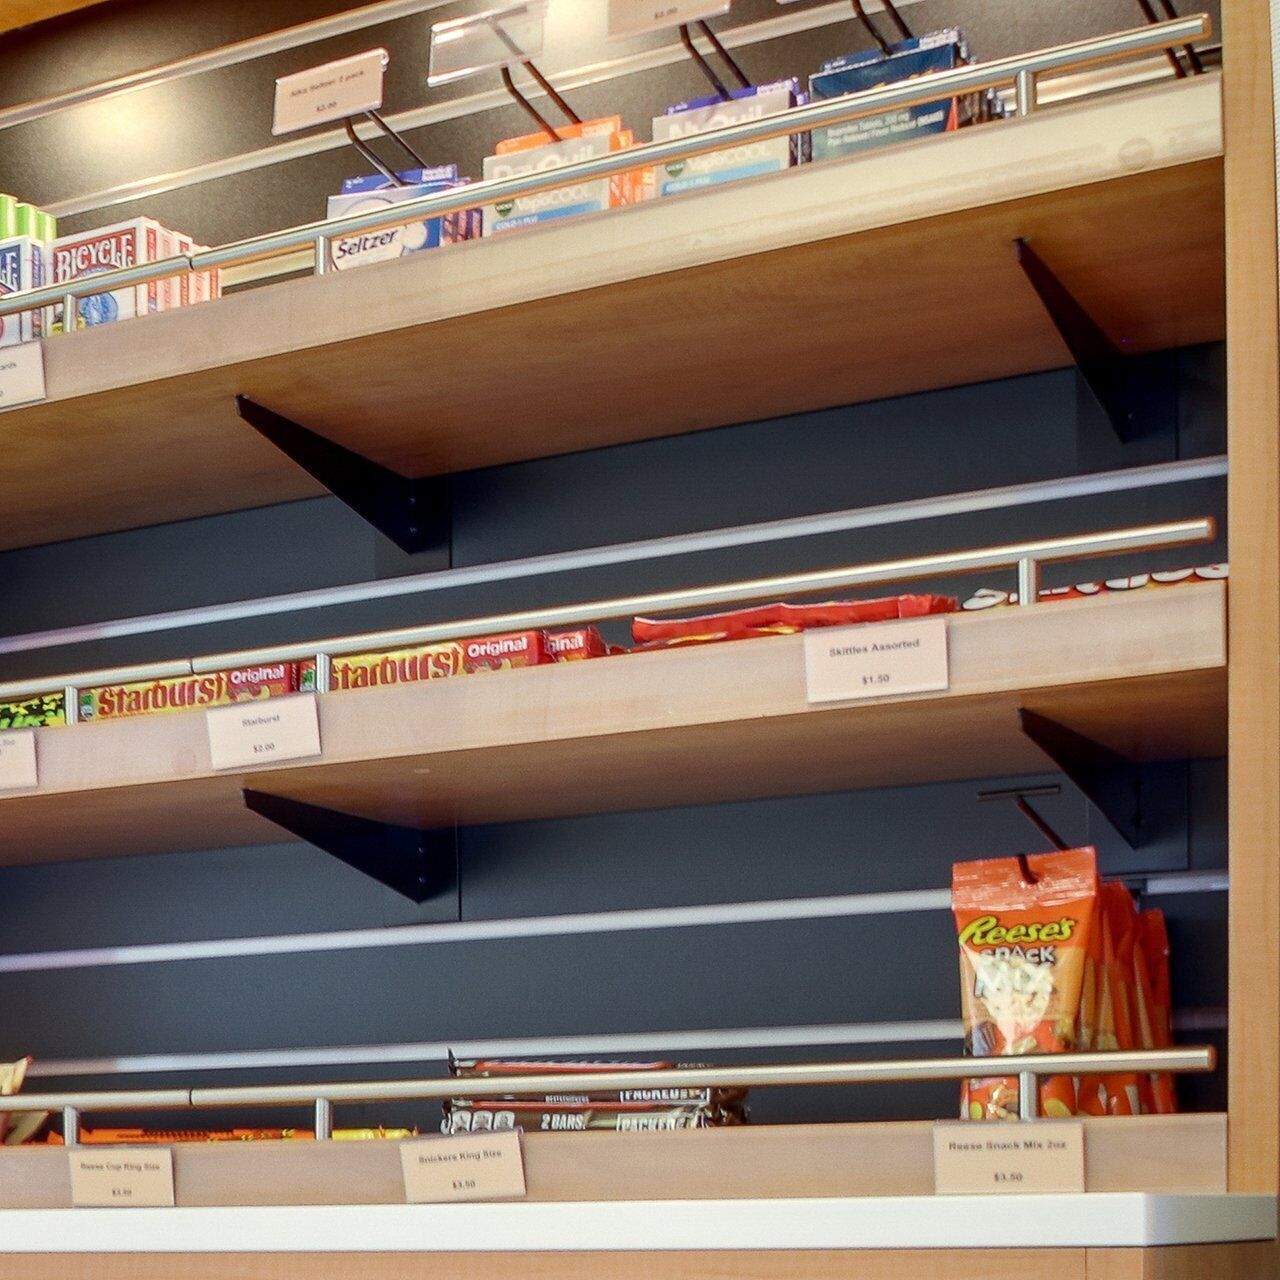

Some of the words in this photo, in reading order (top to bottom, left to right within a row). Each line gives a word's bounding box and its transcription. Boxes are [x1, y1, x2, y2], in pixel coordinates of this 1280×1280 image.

[336, 229, 397, 260] Seltzer
[55, 233, 134, 283] BICYCLE
[467, 635, 528, 659] Original
[829, 644, 869, 659] Skittles
[871, 638, 920, 653] Assorted
[230, 665, 286, 685] Original
[98, 671, 227, 717] Starburst
[241, 714, 280, 728] Starburst
[958, 914, 1078, 947] Reese's
[541, 1114, 551, 1129] 2
[1022, 1140, 1044, 1151] Mix
[419, 1153, 458, 1165] Snickers
[459, 1151, 482, 1163] King
[483, 1149, 502, 1159] Size
